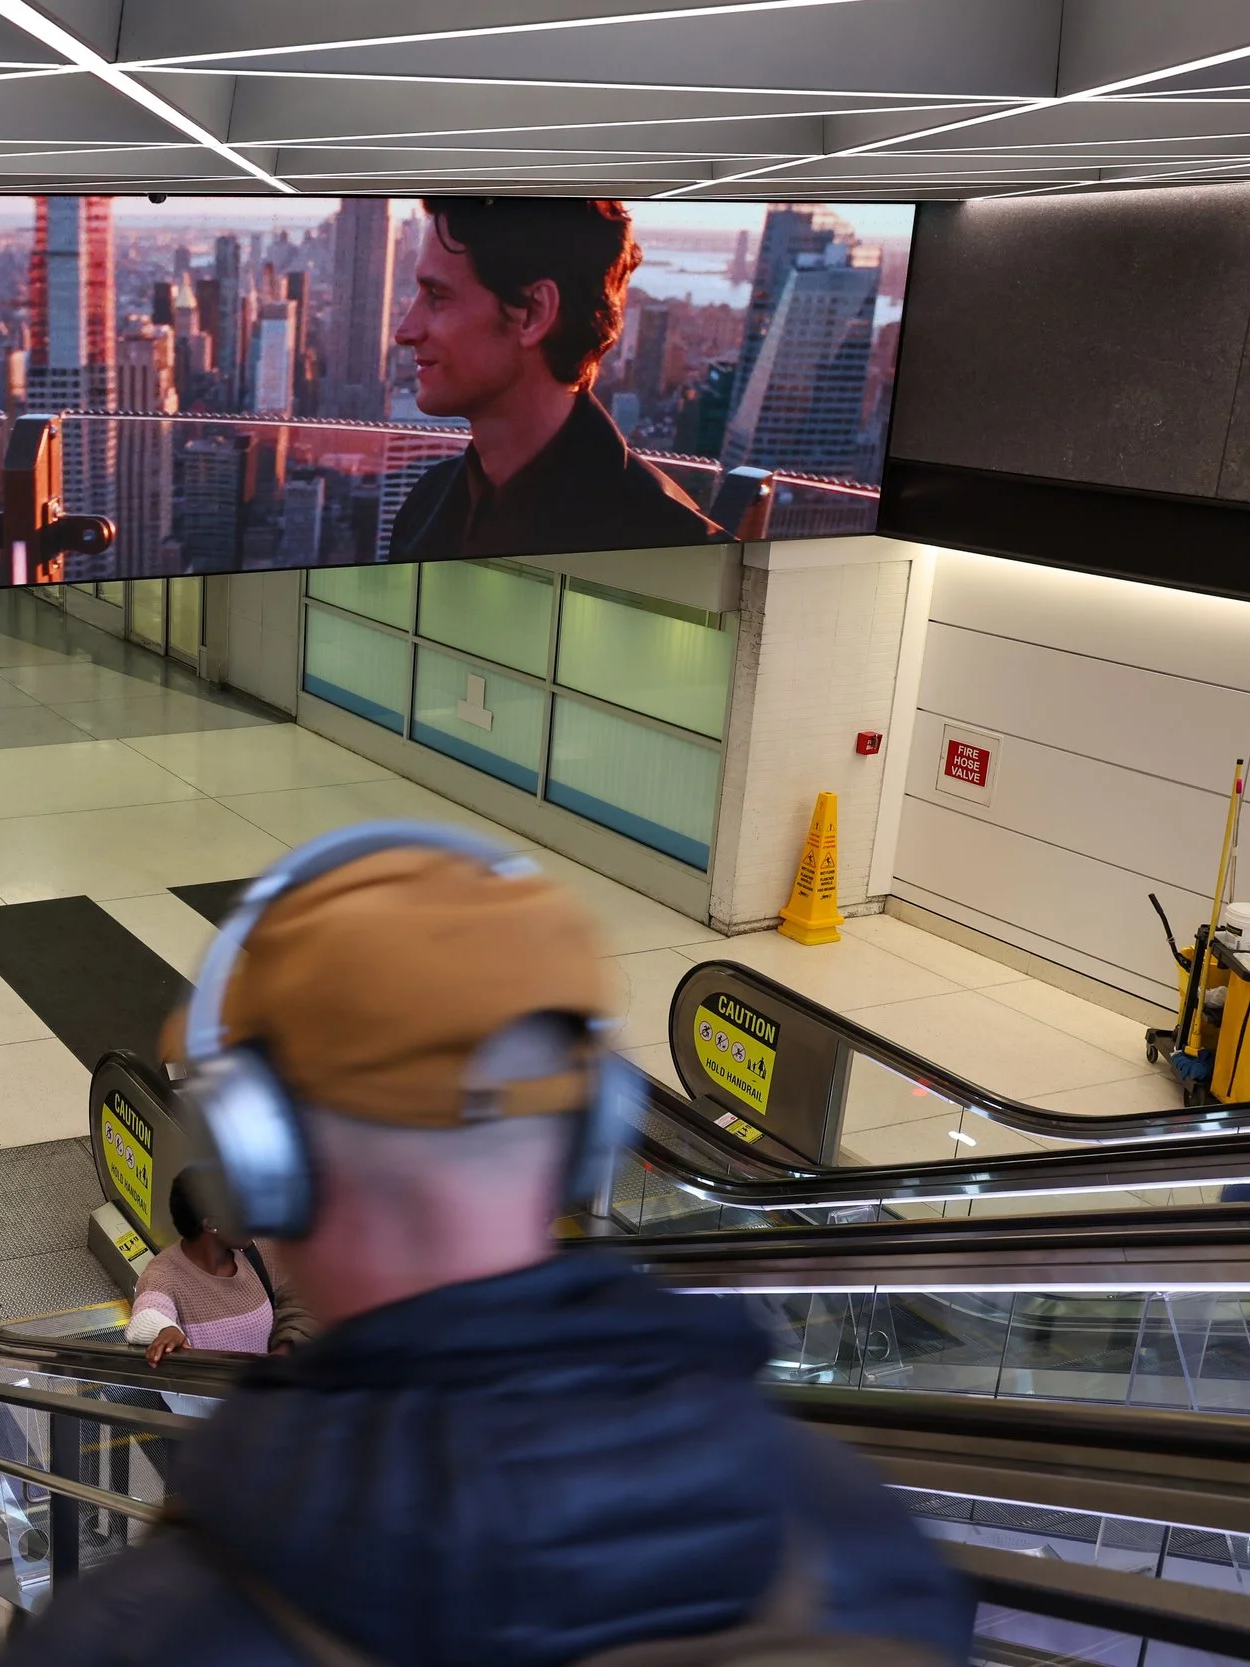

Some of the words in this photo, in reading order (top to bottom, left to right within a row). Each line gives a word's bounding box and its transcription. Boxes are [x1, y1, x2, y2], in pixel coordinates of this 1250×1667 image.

[951, 765, 981, 783] VALVE
[954, 755, 980, 771] HOSE
[958, 745, 979, 760] FIRE
[718, 995, 776, 1044] CAUTION
[706, 1057, 725, 1078] HOLD
[726, 1069, 763, 1103] HANDRAIL
[114, 1093, 151, 1149] CAUTION
[111, 1162, 124, 1184] HOLD
[124, 1180, 148, 1216] HANDRAIL
